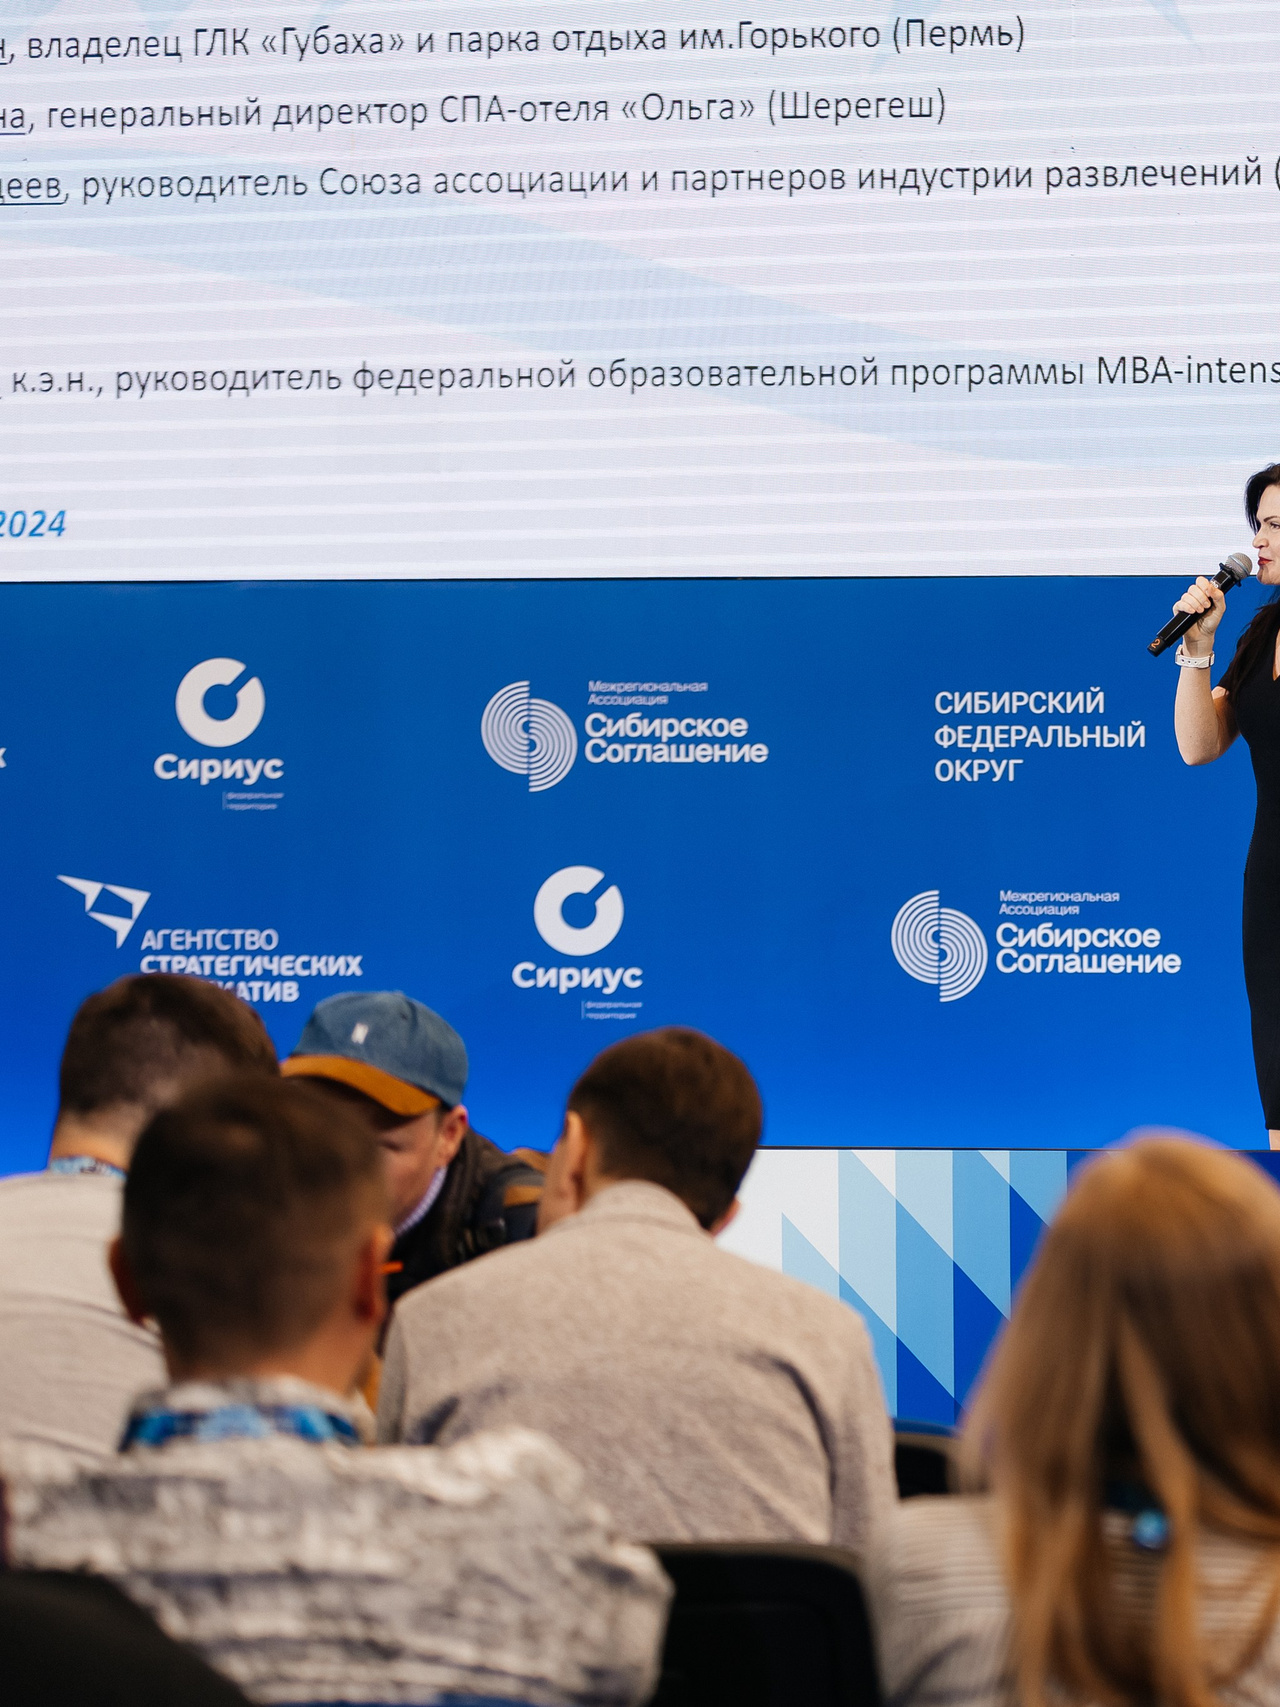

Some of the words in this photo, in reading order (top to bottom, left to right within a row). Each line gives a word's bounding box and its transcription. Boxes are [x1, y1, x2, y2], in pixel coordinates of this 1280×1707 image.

[27, 35, 183, 65] владелец
[194, 27, 250, 58] ГЛК
[260, 23, 405, 63] «Губаха»
[416, 31, 435, 54] и
[447, 30, 540, 60] парка
[551, 28, 667, 59] отдыха
[679, 19, 881, 57] им.Горького
[892, 14, 1025, 55] (Пермь)
[47, 96, 262, 136] генеральный
[271, 101, 429, 133] директор
[439, 94, 609, 124] СПА-отеля
[621, 91, 755, 122] «Ольга»
[768, 86, 946, 127] (Шерегеш)
[0, 176, 70, 207] еев,
[82, 173, 309, 206] руководитель
[318, 166, 421, 197] Союза
[433, 170, 629, 195] ассоциации
[641, 170, 659, 192] и
[671, 167, 847, 199] партнеров
[857, 166, 1033, 197] индустрии
[1045, 154, 1262, 196] развлечений
[12, 371, 104, 398] к.э.н.,
[115, 368, 343, 400] руководитель
[352, 357, 576, 397] федеральной
[587, 355, 879, 395] образовательной
[890, 362, 1085, 394] программы
[1150, 637, 1161, 649] 2
[588, 680, 708, 694] Межрегиональная
[588, 694, 668, 706] Ассоциация
[934, 686, 1105, 714] СИБИРСКИЙ
[584, 712, 748, 742] Сибирское
[934, 720, 1146, 753] ФЕДЕРАЛЬНЫЙ
[585, 738, 769, 763] Соглашение
[153, 753, 284, 786] Сириус
[934, 758, 1024, 782] ОКРУГ
[999, 890, 1120, 906] Межрегиональная
[999, 903, 1080, 916] Ассоциация
[141, 929, 279, 951] АГЕНТСТВО
[995, 922, 1161, 954] Сибирское
[141, 955, 362, 976] СТРАТЕГИЧЕСКИХ
[996, 947, 1182, 974] Соглашение
[511, 961, 643, 995] Сириус
